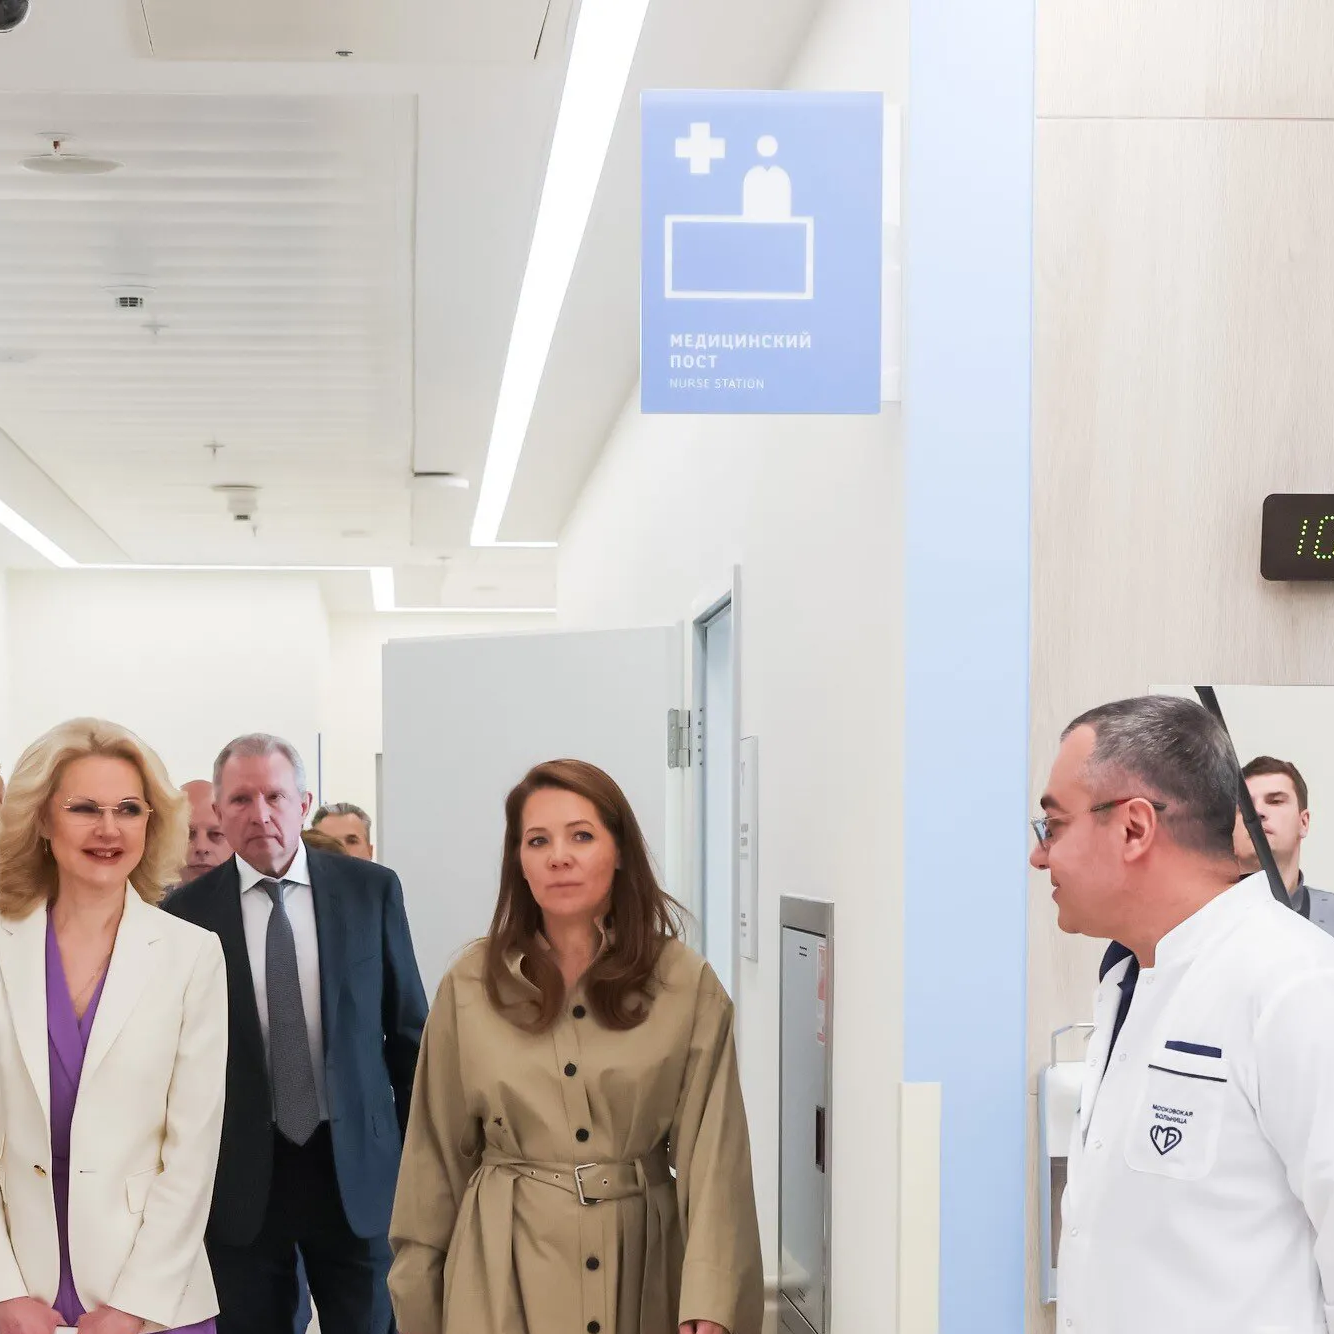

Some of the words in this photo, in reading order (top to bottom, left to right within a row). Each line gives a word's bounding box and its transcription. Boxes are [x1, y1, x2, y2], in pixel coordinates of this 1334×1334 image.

[670, 331, 811, 350] МЕДИЦИНСКИЙ
[670, 355, 717, 368] ПОСТ
[670, 378, 709, 388] NURSE
[715, 378, 765, 389] STATION
